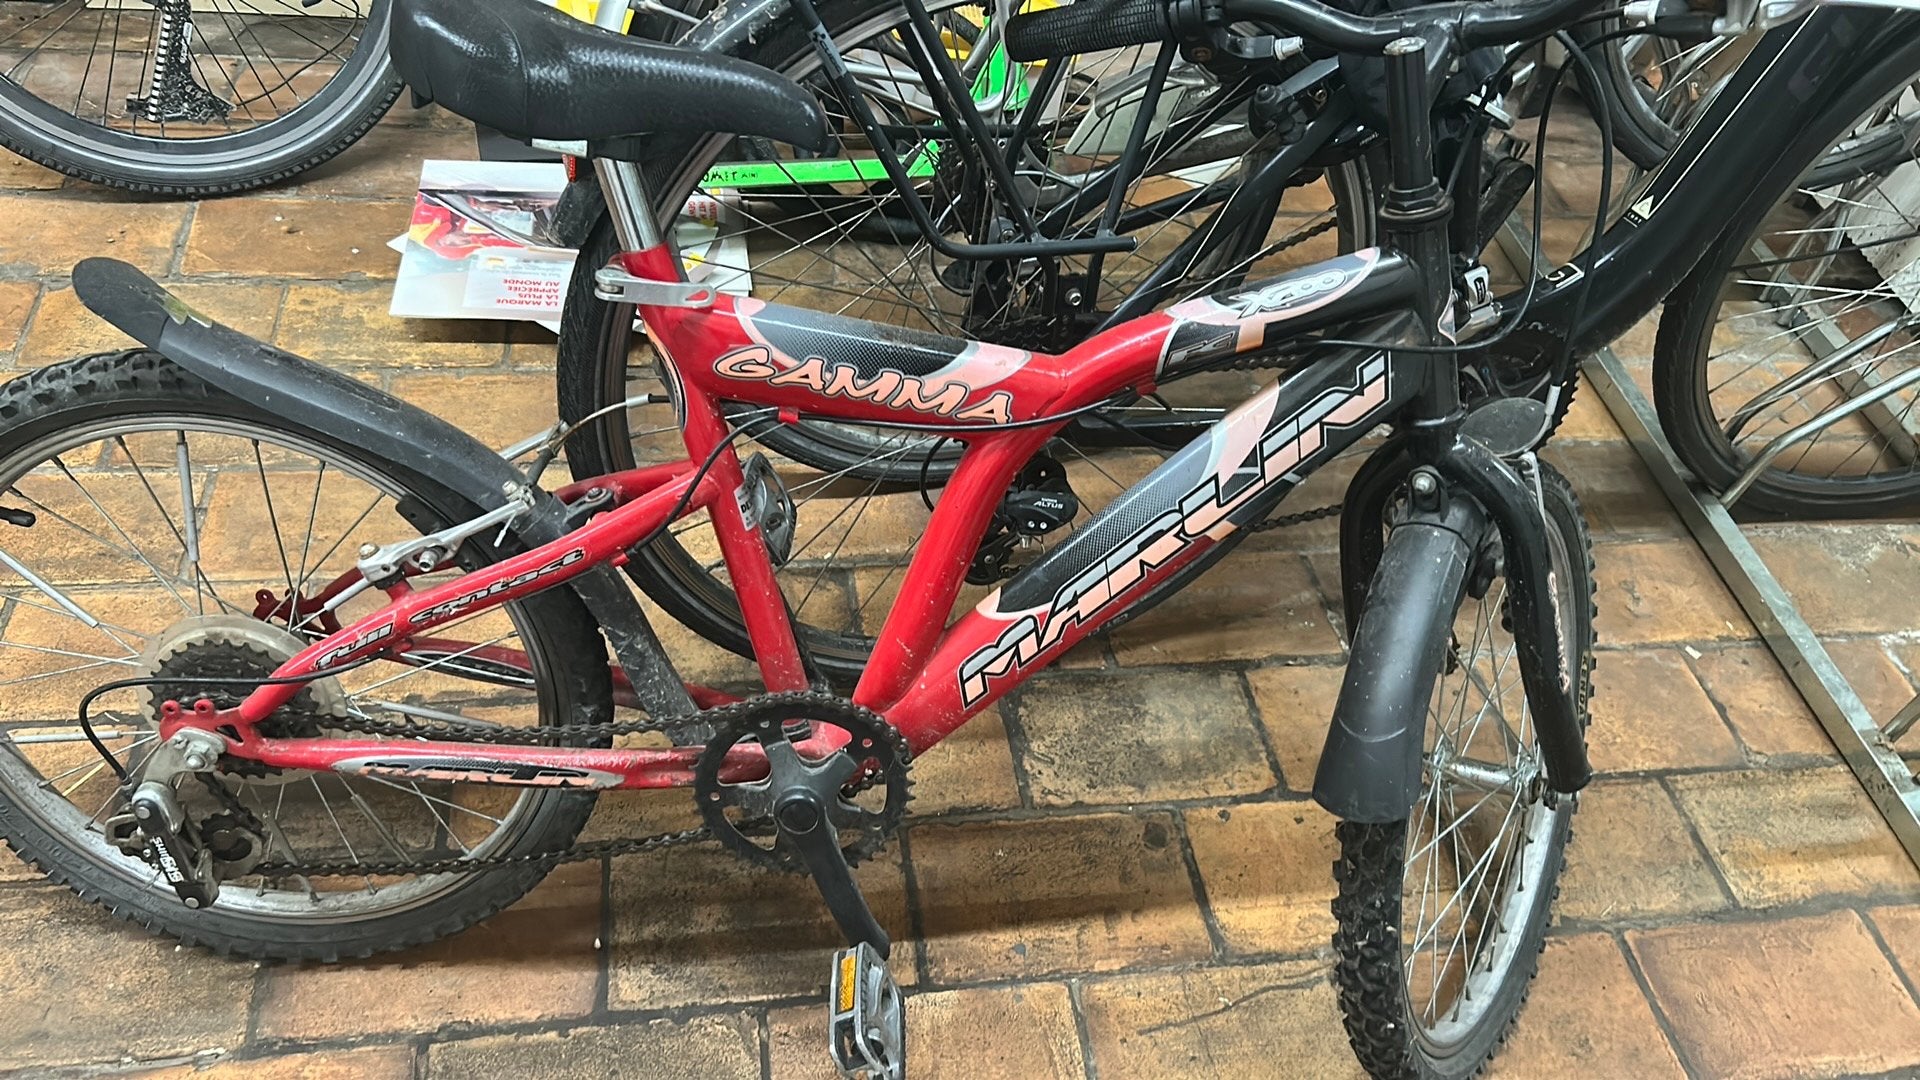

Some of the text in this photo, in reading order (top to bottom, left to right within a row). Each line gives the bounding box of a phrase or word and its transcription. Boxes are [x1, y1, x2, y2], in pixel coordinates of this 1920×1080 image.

[496, 298, 541, 306] MARQUE
[713, 345, 1012, 424] GAMMA
[957, 350, 1391, 709] MARLIN
[1033, 500, 1064, 510] ALTUS
[1579, 654, 1588, 715] KENDA
